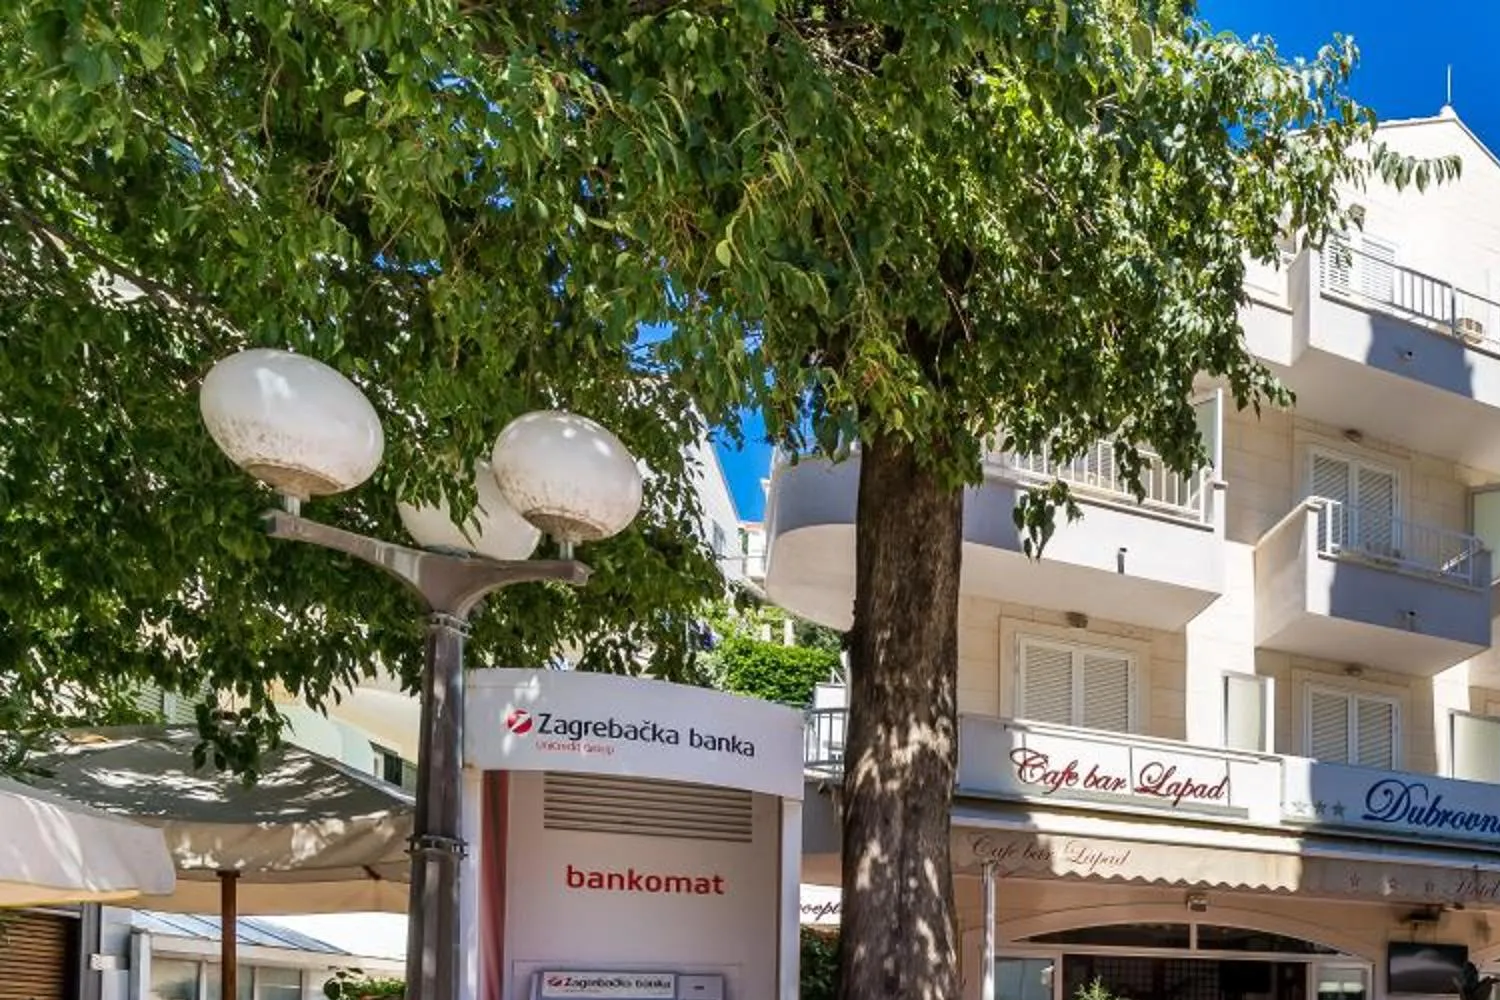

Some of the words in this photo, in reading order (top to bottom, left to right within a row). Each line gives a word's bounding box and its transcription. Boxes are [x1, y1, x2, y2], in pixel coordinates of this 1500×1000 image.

[538, 713, 679, 744] Zagrebačka
[690, 728, 755, 757] banka
[1009, 748, 1079, 794] Cafe
[1083, 764, 1128, 791] bar
[1134, 762, 1225, 807] Lapad
[566, 865, 725, 895] bankomat
